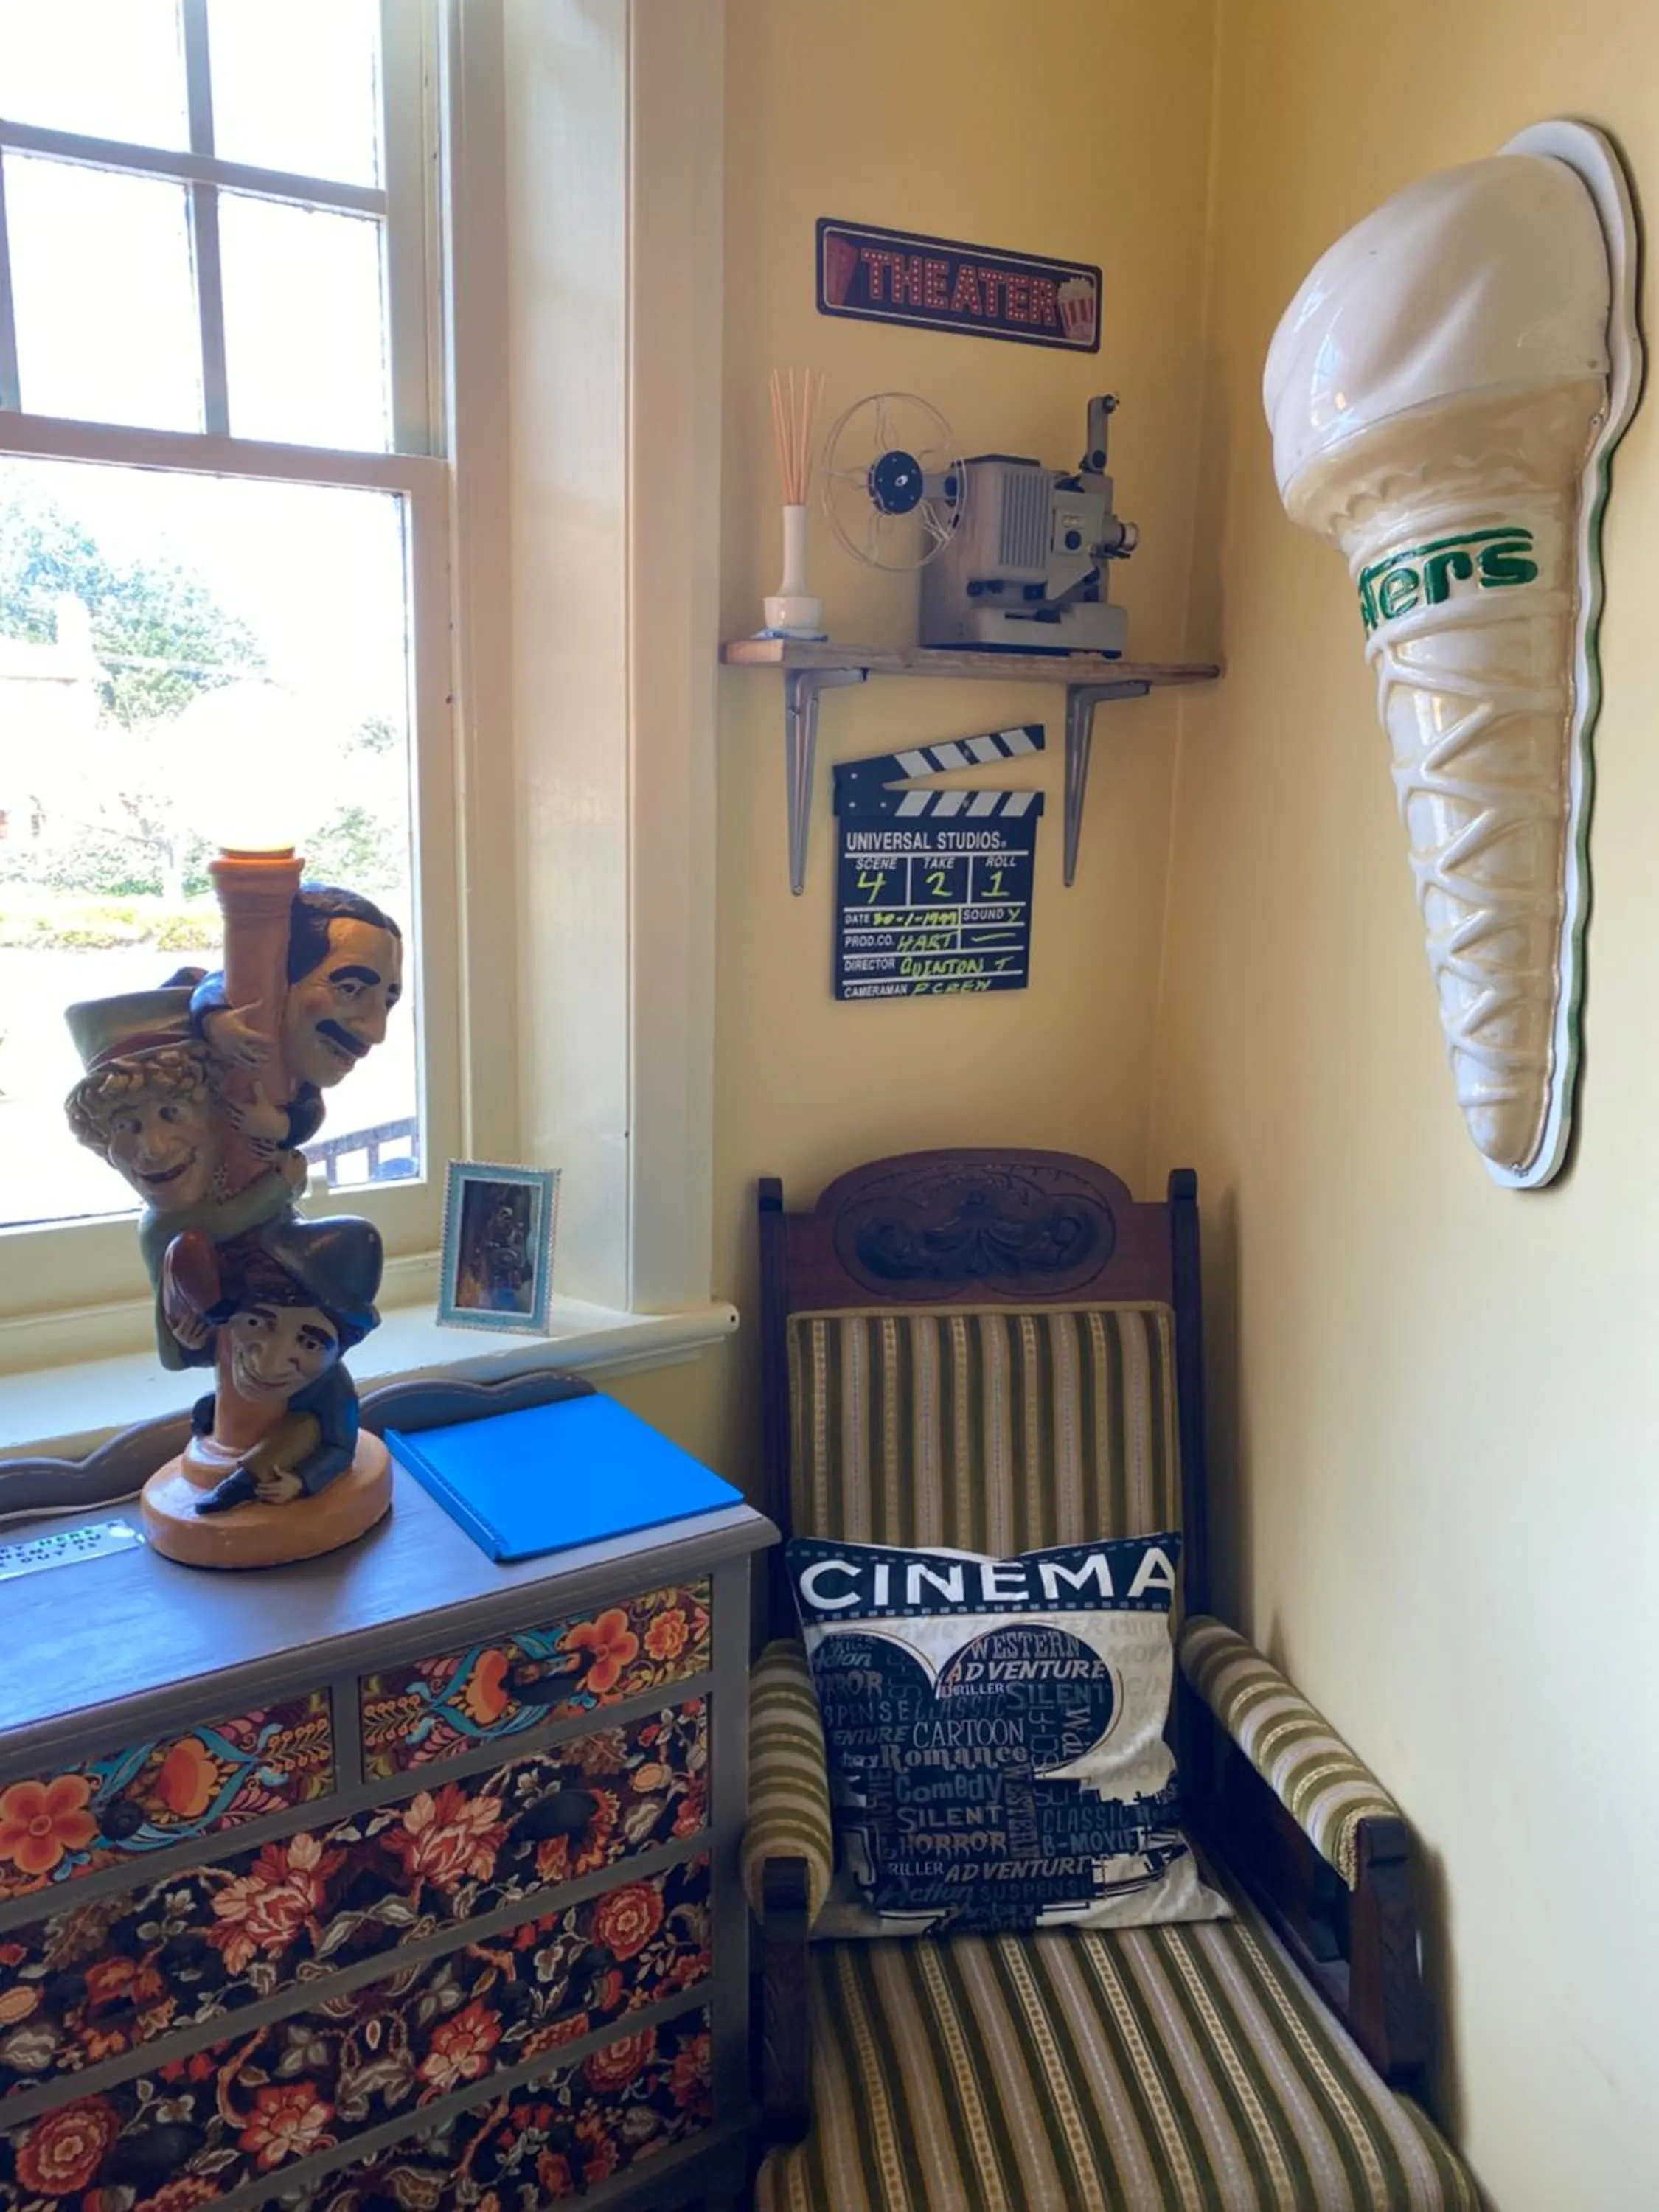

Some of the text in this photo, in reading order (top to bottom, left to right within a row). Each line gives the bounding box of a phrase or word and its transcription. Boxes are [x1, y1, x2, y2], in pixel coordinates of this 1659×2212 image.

[861, 247, 1057, 327] THEATER
[846, 831, 931, 850] UNIVERSAL
[855, 858, 897, 870] SCENE
[922, 857, 955, 869] TAKE
[985, 855, 1017, 867] ROLL
[856, 871, 886, 905] 4
[925, 871, 953, 897] 2
[981, 870, 1010, 897] 1
[844, 914, 870, 925] DATE
[963, 908, 1004, 922] SOUND
[844, 959, 896, 972] DIRECTOR
[844, 984, 908, 998] CAMERAMAN
[799, 1548, 1175, 1610] CINEMA
[970, 1630, 1080, 1660] WESTERN
[945, 1660, 1105, 1683] ADVENTURE
[1006, 1680, 1107, 1711] SILENT
[913, 1717, 1025, 1749] CARTOON
[880, 1743, 1028, 1775] Romance
[895, 1773, 1004, 1807] Comedy
[896, 1805, 1003, 1834] SILENT
[1043, 1806, 1131, 1834] CLASSIC
